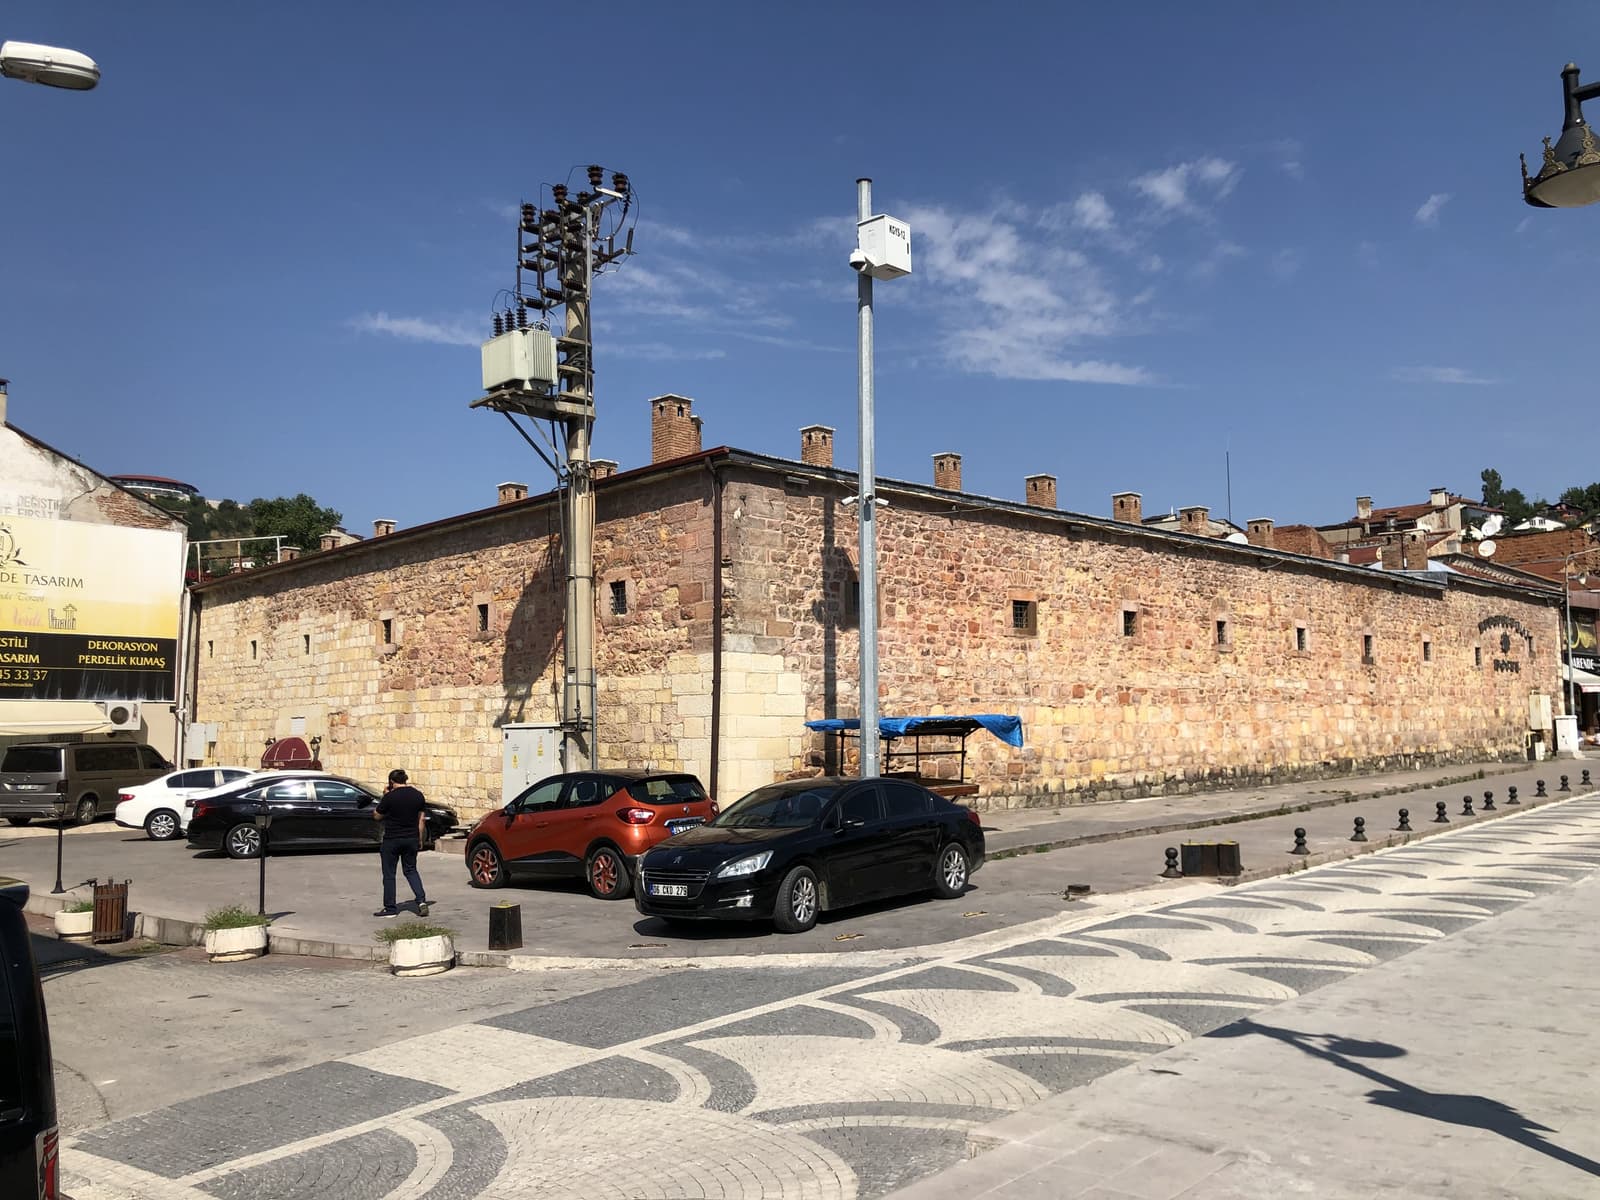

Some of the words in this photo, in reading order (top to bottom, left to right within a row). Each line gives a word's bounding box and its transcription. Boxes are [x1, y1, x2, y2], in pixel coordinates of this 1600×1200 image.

[24, 573, 84, 588] TASARIM
[0, 636, 28, 649] STİLİ
[88, 640, 158, 652] DEKORASYON
[78, 653, 127, 665] PERDELİK
[129, 656, 166, 669] KUMAŞ
[14, 669, 29, 681] 33
[32, 669, 49, 681] 37
[676, 886, 688, 896] 279
